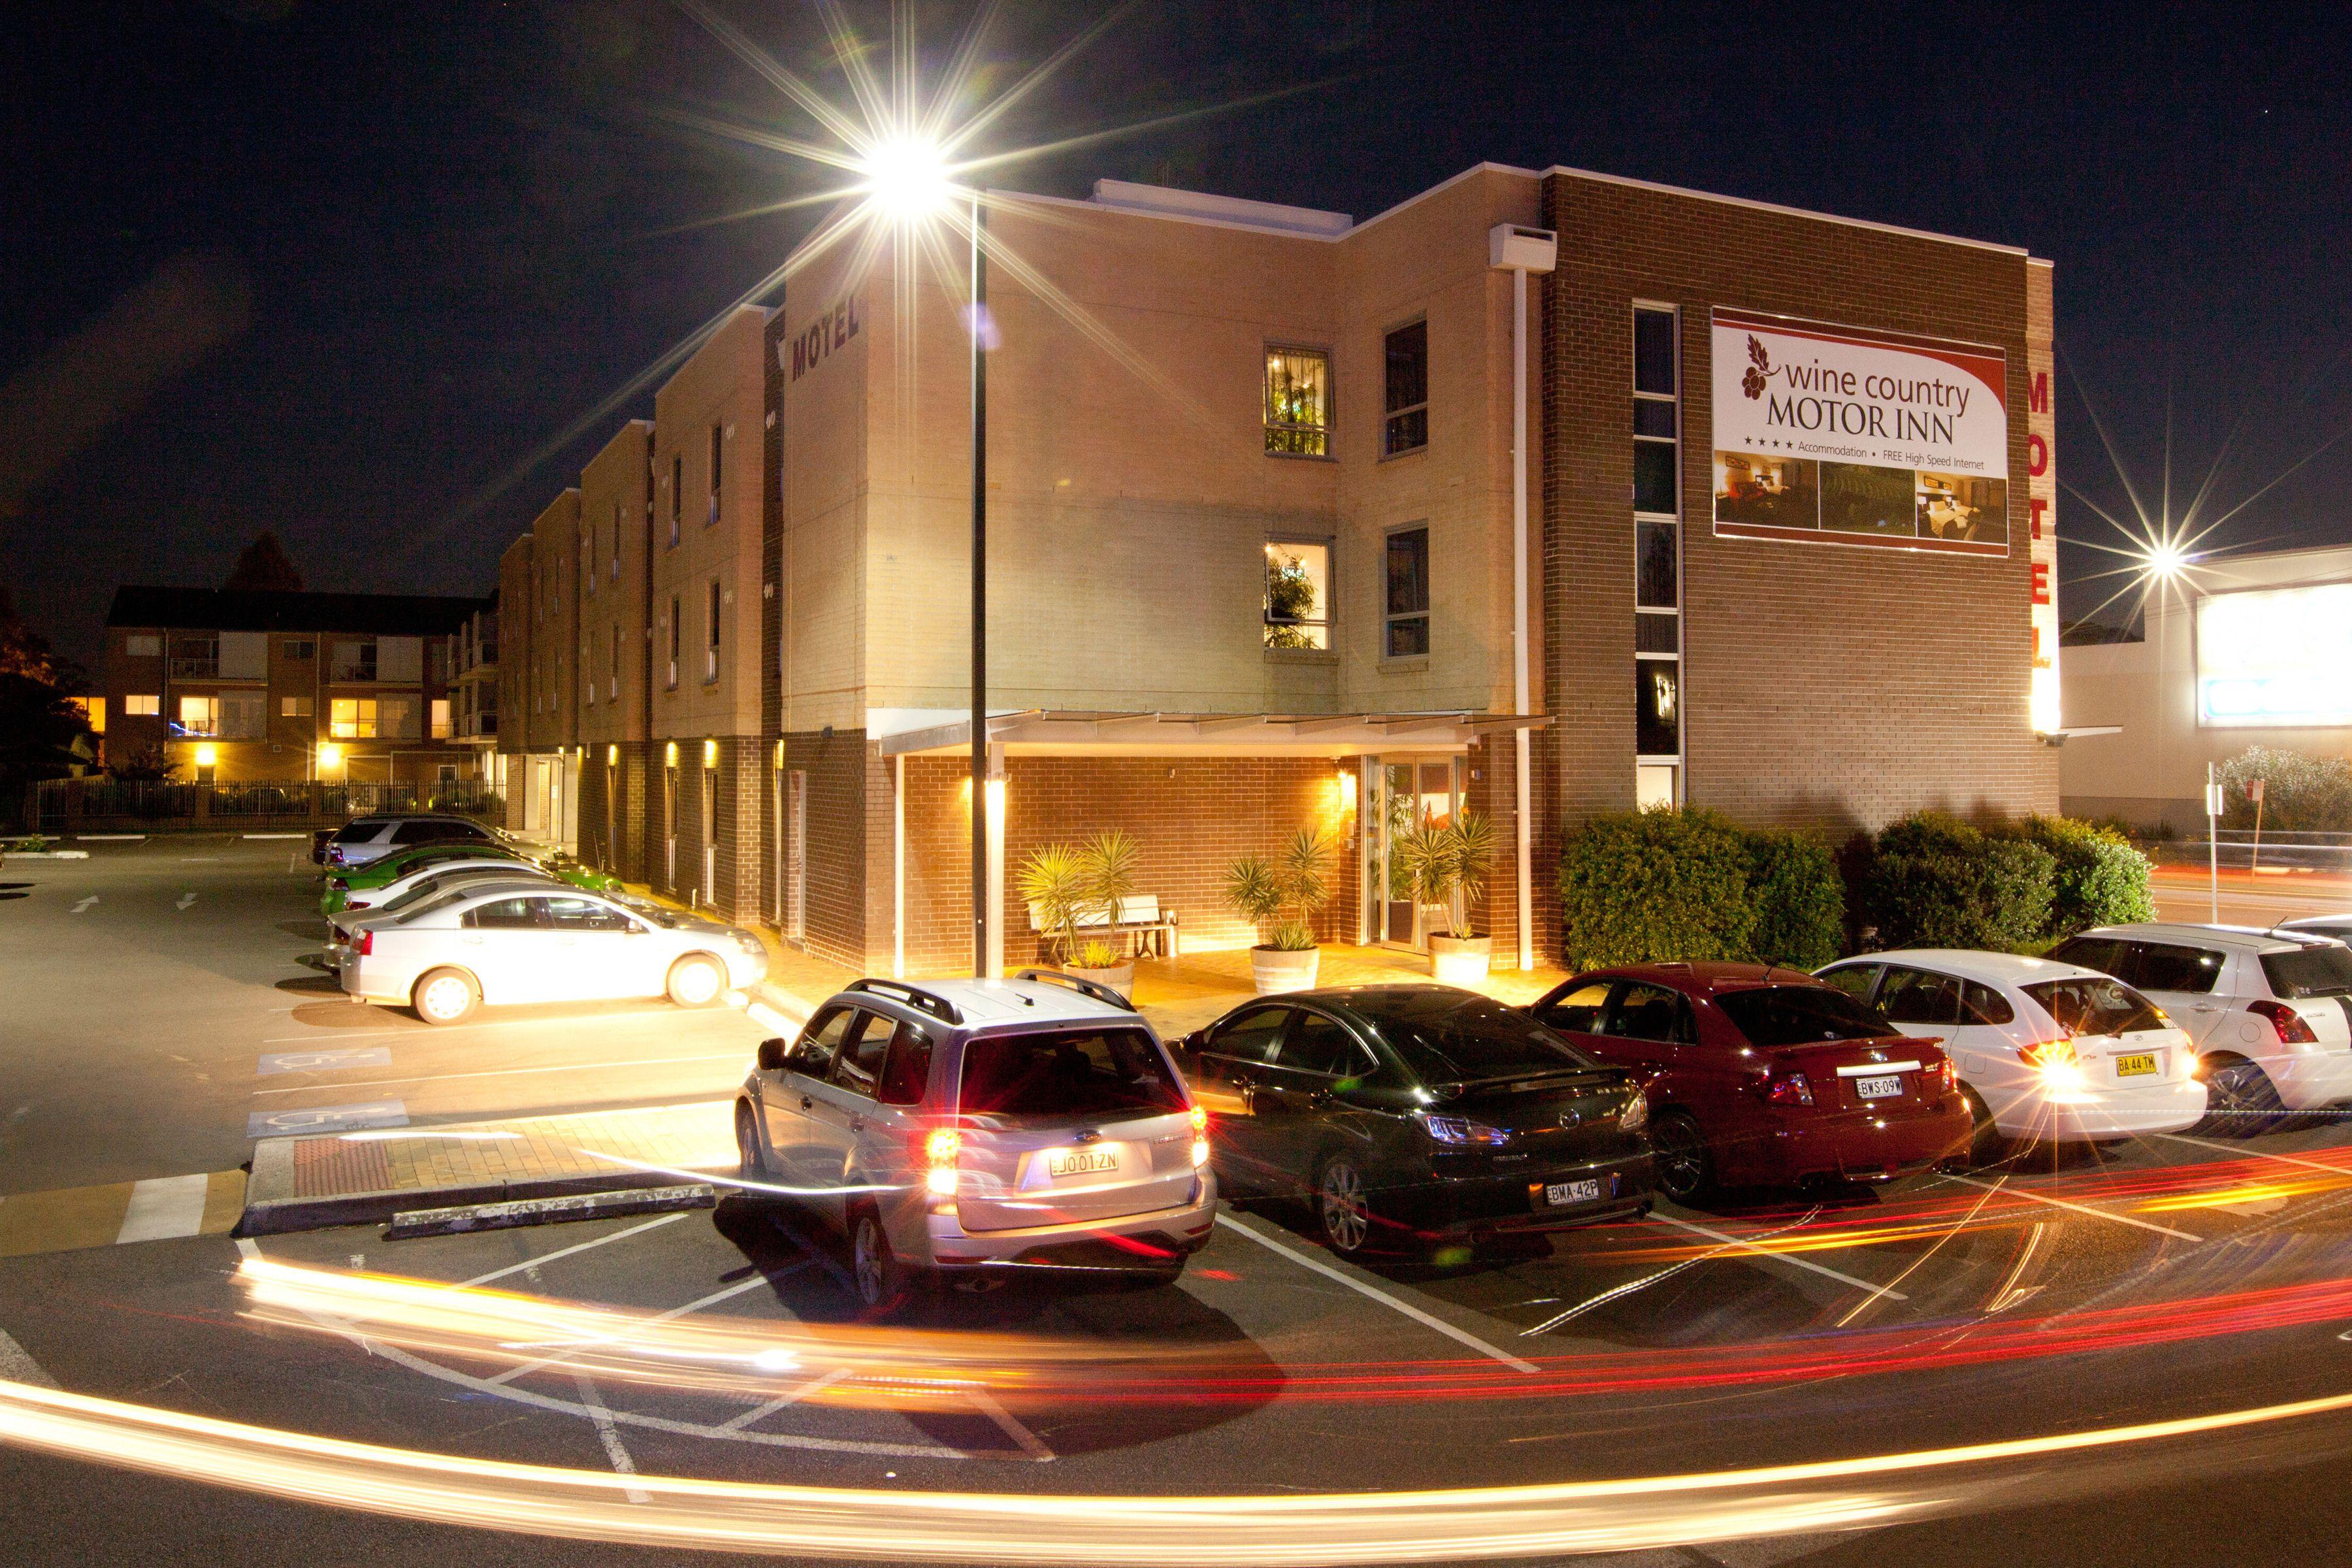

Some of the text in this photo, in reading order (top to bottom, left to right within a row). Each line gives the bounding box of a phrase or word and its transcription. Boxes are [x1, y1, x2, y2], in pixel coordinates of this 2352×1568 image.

[792, 294, 859, 382] MOTEL
[1785, 359, 1970, 418] wine country
[1767, 392, 1955, 445] MOTOR INN
[1798, 441, 1985, 470] Accommodation FREE High Speed Internet
[2027, 372, 2051, 670] MOTEL
